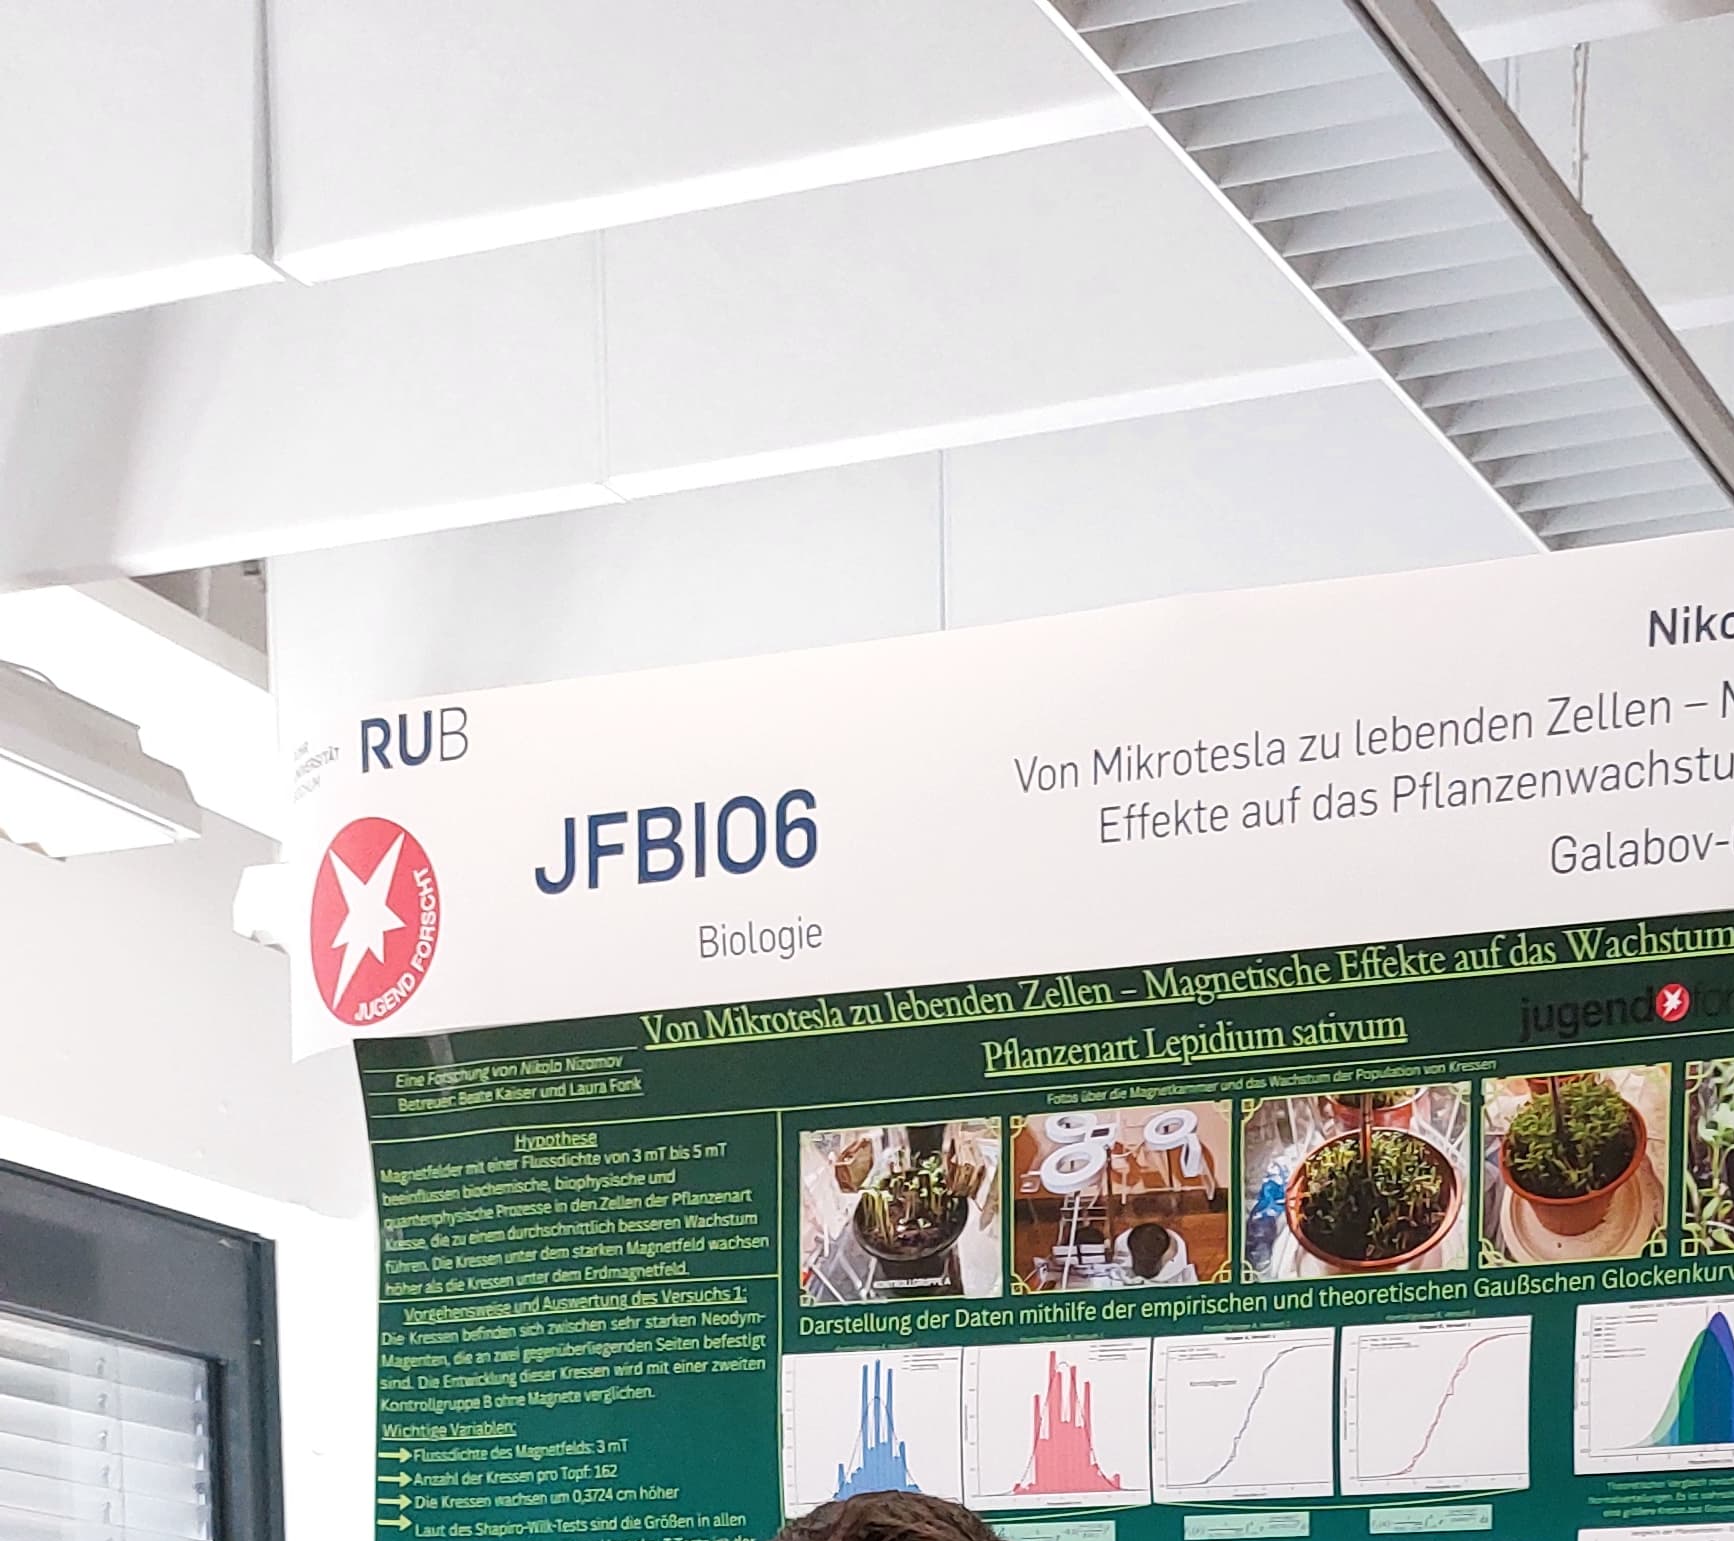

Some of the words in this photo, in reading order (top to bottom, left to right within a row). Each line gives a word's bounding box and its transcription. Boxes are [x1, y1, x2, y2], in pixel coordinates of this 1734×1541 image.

[361, 707, 468, 773] RUB
[1014, 756, 1079, 793] Von
[1093, 731, 1285, 786] Mikrotesla
[1299, 732, 1341, 763] zu
[1355, 706, 1533, 757] lebenden
[1547, 692, 1671, 736] Zellen
[1100, 799, 1228, 843] Effekte
[1242, 785, 1301, 829] auf
[1312, 783, 1377, 821] das
[354, 973, 416, 1021] JUGEND
[410, 868, 437, 972] FORSCHT
[699, 916, 823, 960] Biologie
[641, 1014, 699, 1045] Von
[704, 998, 844, 1039] Mikrotesla
[850, 1001, 881, 1026] zu
[888, 986, 1012, 1024] lebenden
[1018, 974, 1112, 1011] Zellen
[1145, 949, 1331, 1004] Magnetische
[1338, 946, 1446, 981] Effekte
[1454, 936, 1504, 971] auf
[1509, 932, 1556, 966] das
[1519, 986, 1655, 1042] jugend
[492, 1064, 517, 1076] von
[981, 1035, 1138, 1072] Pflanzenart
[1144, 1018, 1286, 1068] Lepidium
[1292, 1012, 1406, 1046] sativum
[496, 1085, 537, 1103] Kaiser
[540, 1081, 566, 1098] und
[570, 1079, 607, 1096] Laura
[610, 1076, 642, 1093] Fonk
[514, 1132, 597, 1151] Hypothese
[514, 1300, 540, 1314] und
[542, 1293, 627, 1315] Auswertung
[632, 1291, 658, 1306] des
[661, 1285, 730, 1305] Versuchs
[800, 1303, 912, 1337] Darstellung
[917, 1310, 950, 1330] der
[956, 1307, 1013, 1329] Daten
[1018, 1300, 1096, 1325] mithilfe
[1102, 1297, 1135, 1322] der
[1140, 1290, 1268, 1323] empirischen
[1274, 1289, 1313, 1311] und
[1318, 1279, 1467, 1308] theoretischen
[1473, 1272, 1595, 1299] Gaußschen
[382, 1423, 447, 1441] Wichtige
